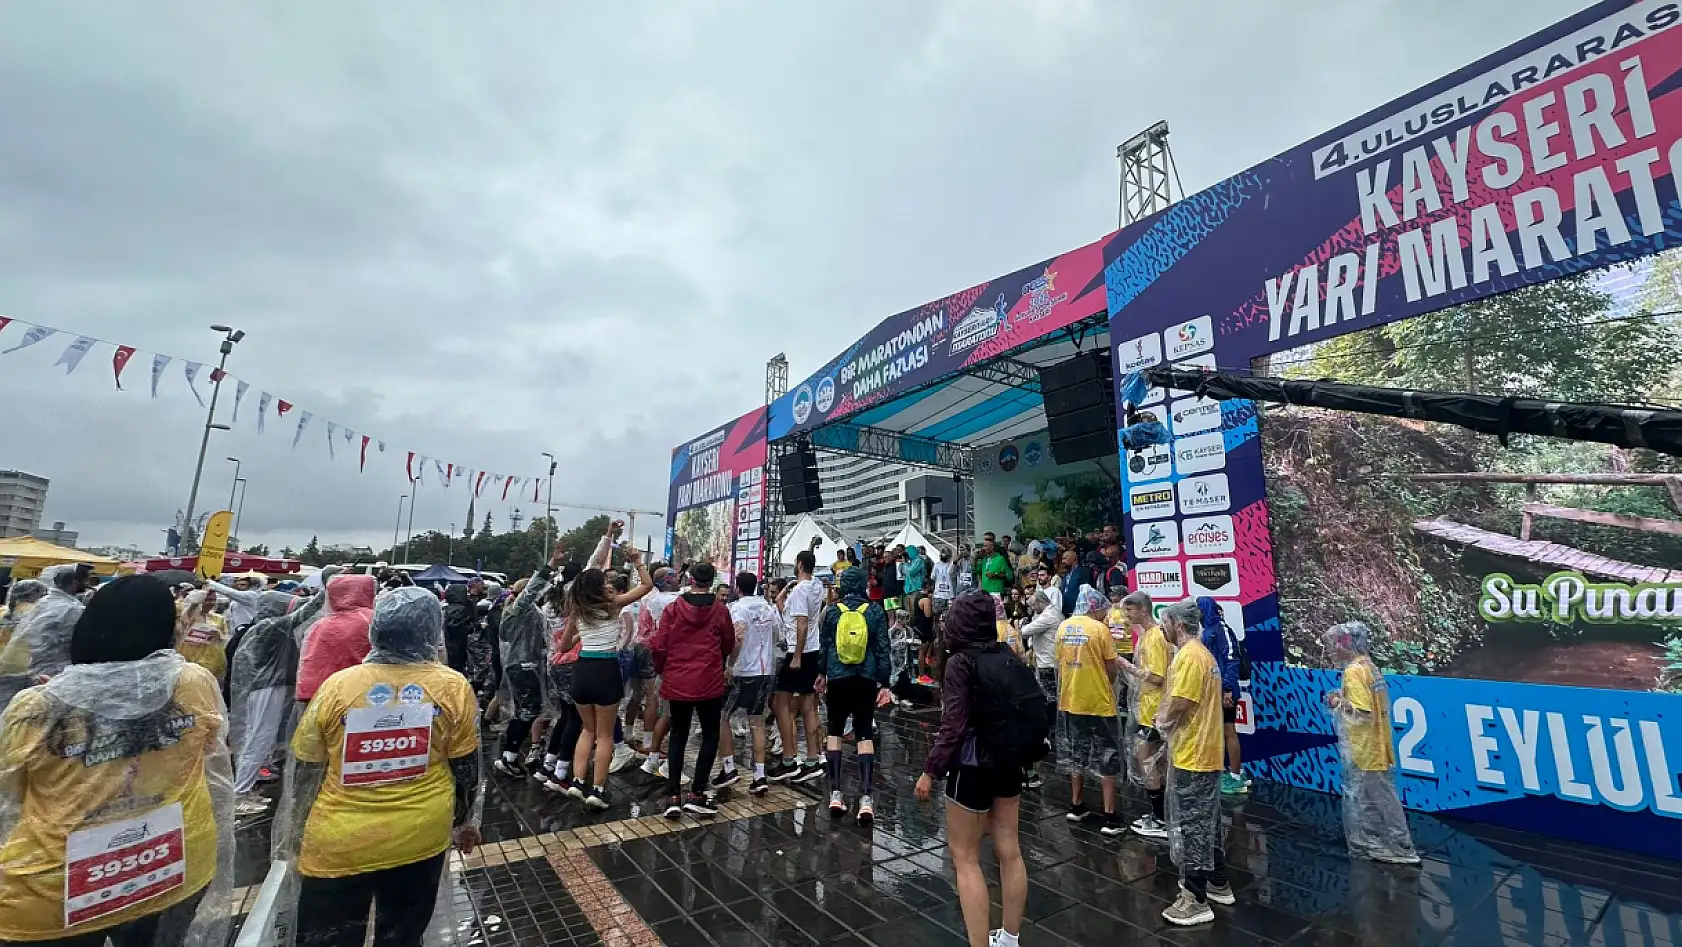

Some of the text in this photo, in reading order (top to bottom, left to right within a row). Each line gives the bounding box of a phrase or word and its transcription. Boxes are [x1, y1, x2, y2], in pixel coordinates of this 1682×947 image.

[1355, 54, 1656, 236] KAYSERİ
[1264, 243, 1381, 341] YARI
[858, 310, 943, 375] MARATONDAN
[853, 344, 928, 399] DAHA FAZLASI
[1133, 490, 1171, 505] METRO
[1482, 576, 1542, 618] Su
[360, 736, 417, 754] 39301
[1465, 704, 1682, 814] EYLÜL
[87, 843, 170, 883] 39303
